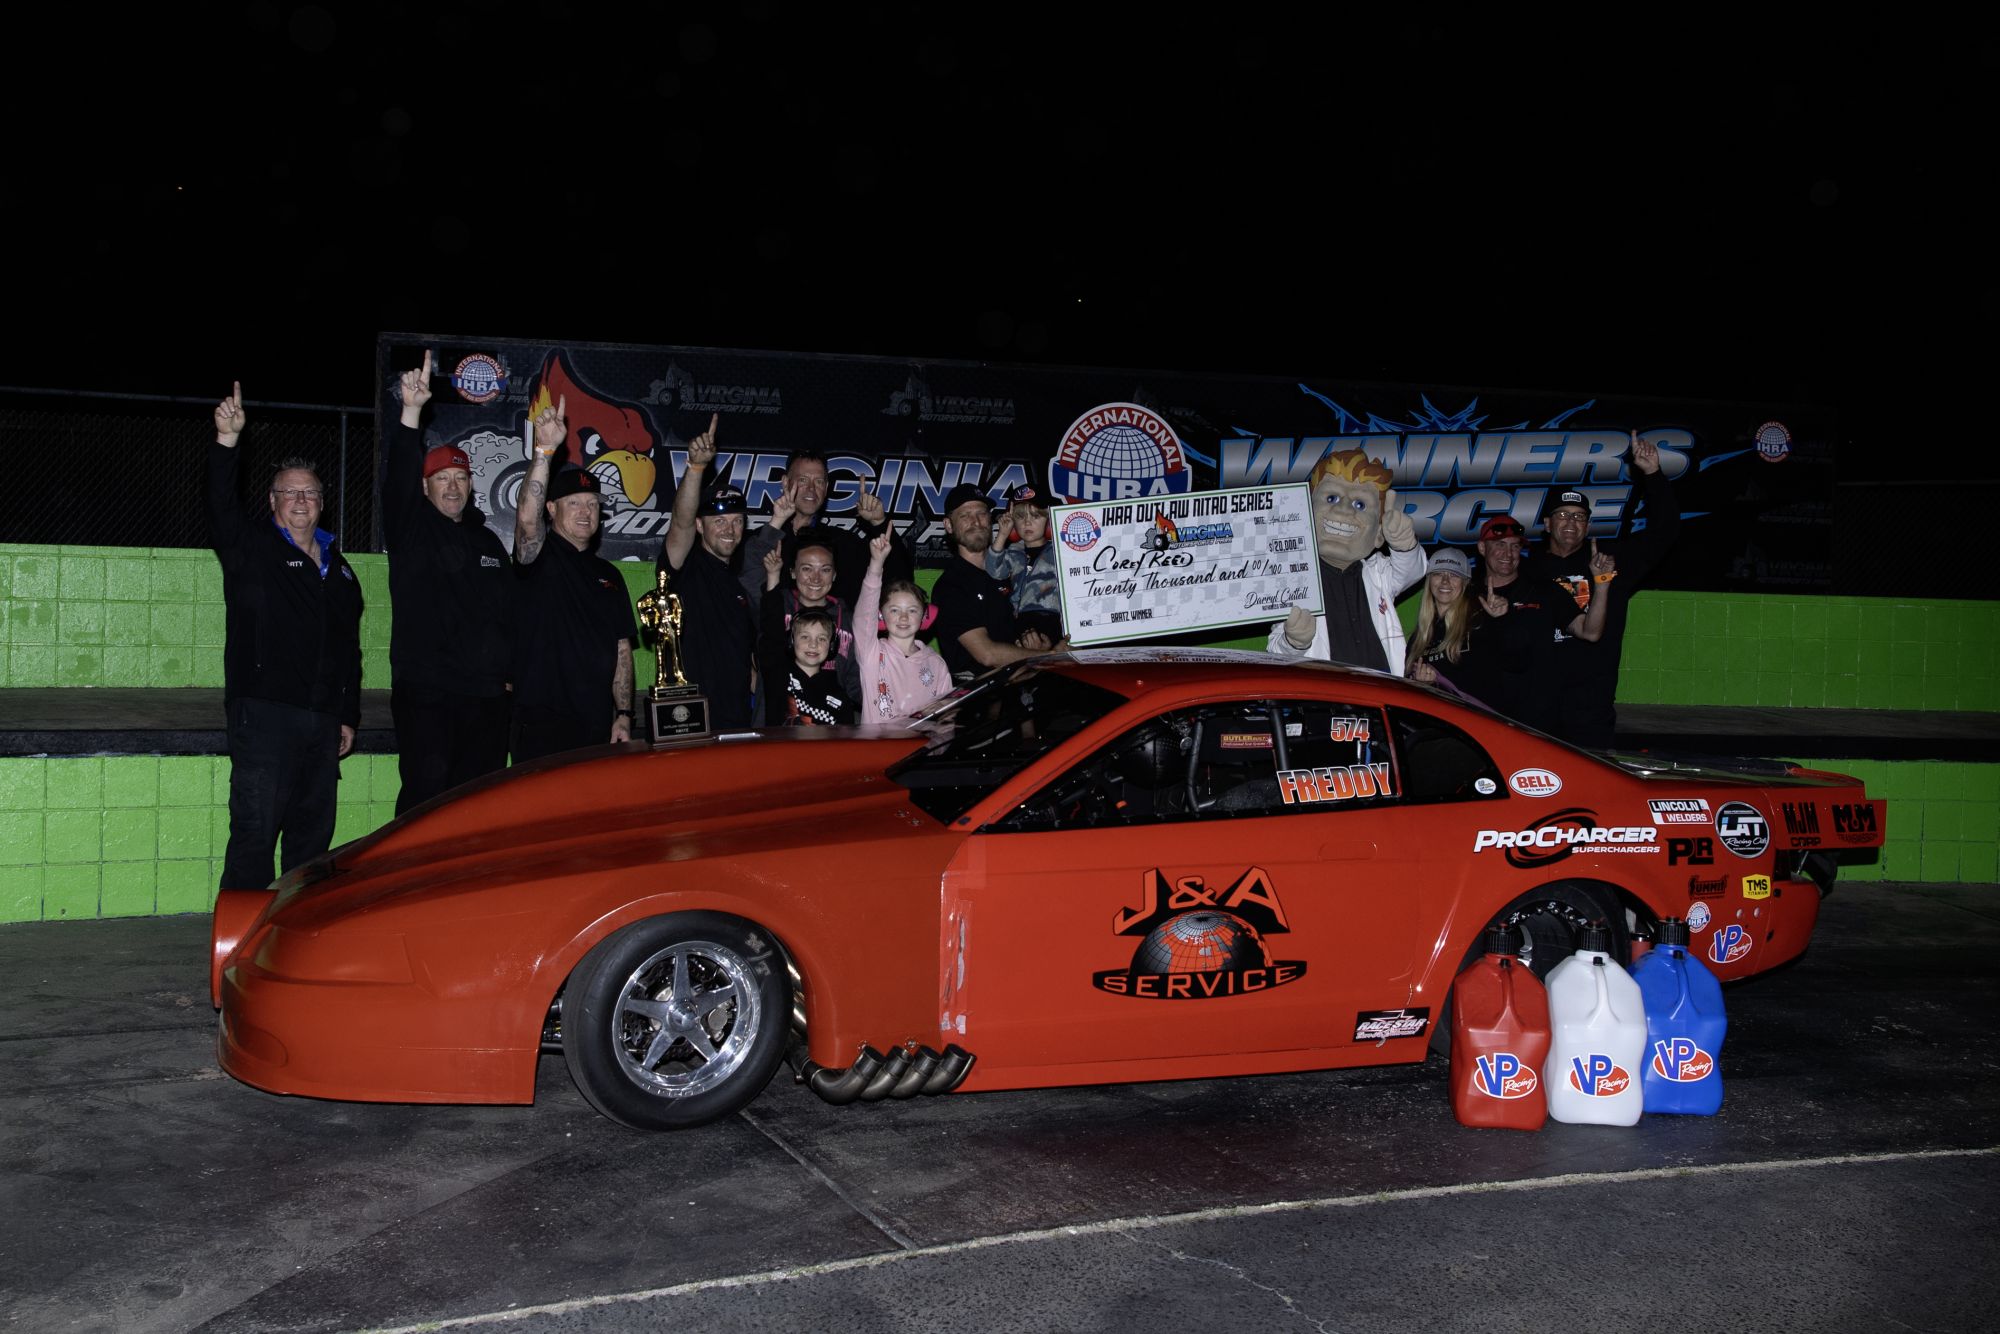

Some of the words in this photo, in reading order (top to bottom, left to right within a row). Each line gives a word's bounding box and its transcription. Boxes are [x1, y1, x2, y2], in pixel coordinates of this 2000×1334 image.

[456, 354, 503, 377] INTERNATIONAL
[457, 378, 500, 391] IHRA
[697, 384, 782, 406] VIRGINIA
[1062, 409, 1181, 469] INTERNATIONAL
[1757, 442, 1789, 452] IHRA
[1220, 427, 1695, 488] WNNERS
[1068, 472, 1170, 500] IHRA
[1102, 505, 1132, 526] IHRA
[1136, 499, 1189, 521] OUTLAW
[1193, 496, 1228, 517] NITRO
[1231, 492, 1273, 513] SERIES
[1394, 485, 1634, 545] RCLE
[1062, 511, 1098, 532] INTERNATIONAL
[1065, 531, 1097, 542] IHRA
[1177, 523, 1234, 542] VIRGINIA
[1070, 567, 1081, 577] PAY
[1083, 578, 1138, 599] Twenty
[1142, 564, 1217, 590] Thousand
[1219, 560, 1250, 580] and
[1330, 717, 1370, 742] 574
[1276, 762, 1391, 804] FREDDY
[1516, 776, 1555, 788] BELL
[1651, 801, 1700, 812] LINCOLN
[1666, 813, 1708, 823] WELDERS
[1720, 816, 1764, 836] LAT
[1572, 846, 1660, 854] SUPERCHARGERS
[1725, 838, 1752, 848] Racing
[1747, 880, 1767, 891] TMS
[1112, 865, 1291, 935] J&A
[1714, 925, 1743, 962] VP
[1102, 965, 1297, 998] SERVICE
[1655, 1038, 1697, 1080] VP
[1681, 1062, 1712, 1077] Racing
[1475, 1053, 1520, 1098] VP
[1571, 1053, 1614, 1096] VP
[1598, 1078, 1629, 1092] Racing
[1505, 1078, 1536, 1093] Racing
